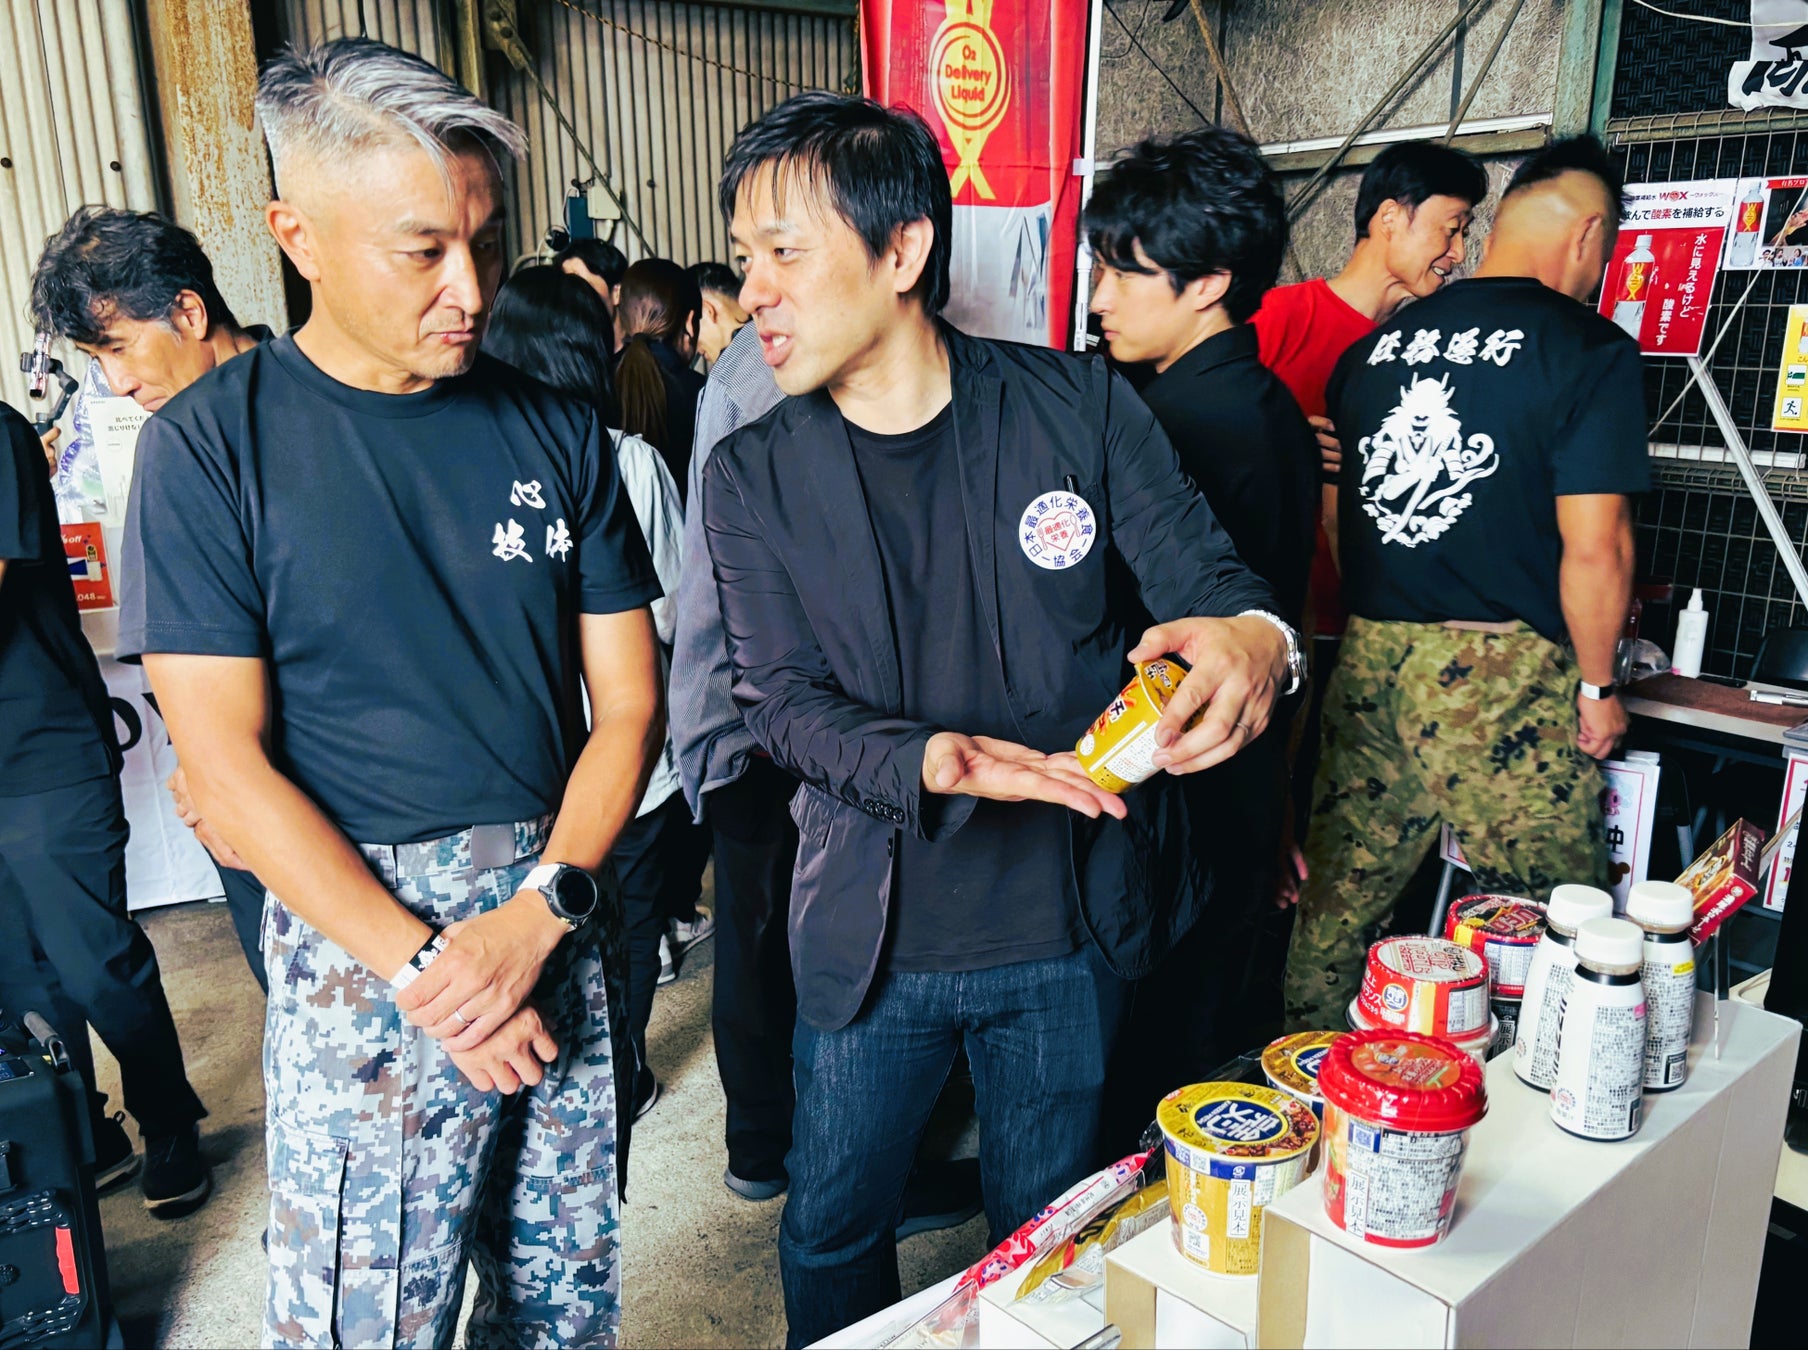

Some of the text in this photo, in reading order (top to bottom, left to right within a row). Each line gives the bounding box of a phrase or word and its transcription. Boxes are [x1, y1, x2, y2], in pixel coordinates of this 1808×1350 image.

[945, 64, 992, 84] Delivery
[951, 85, 986, 103] Liquid
[1679, 233, 1708, 319] 水に見えるけど
[1655, 298, 1676, 346] 酸素です
[1366, 326, 1526, 367] 任務遂行
[510, 479, 547, 509] 心
[1224, 1111, 1281, 1141] 完全
[1232, 1183, 1249, 1234] 展示見本
[1350, 1175, 1366, 1234] 展示見本
